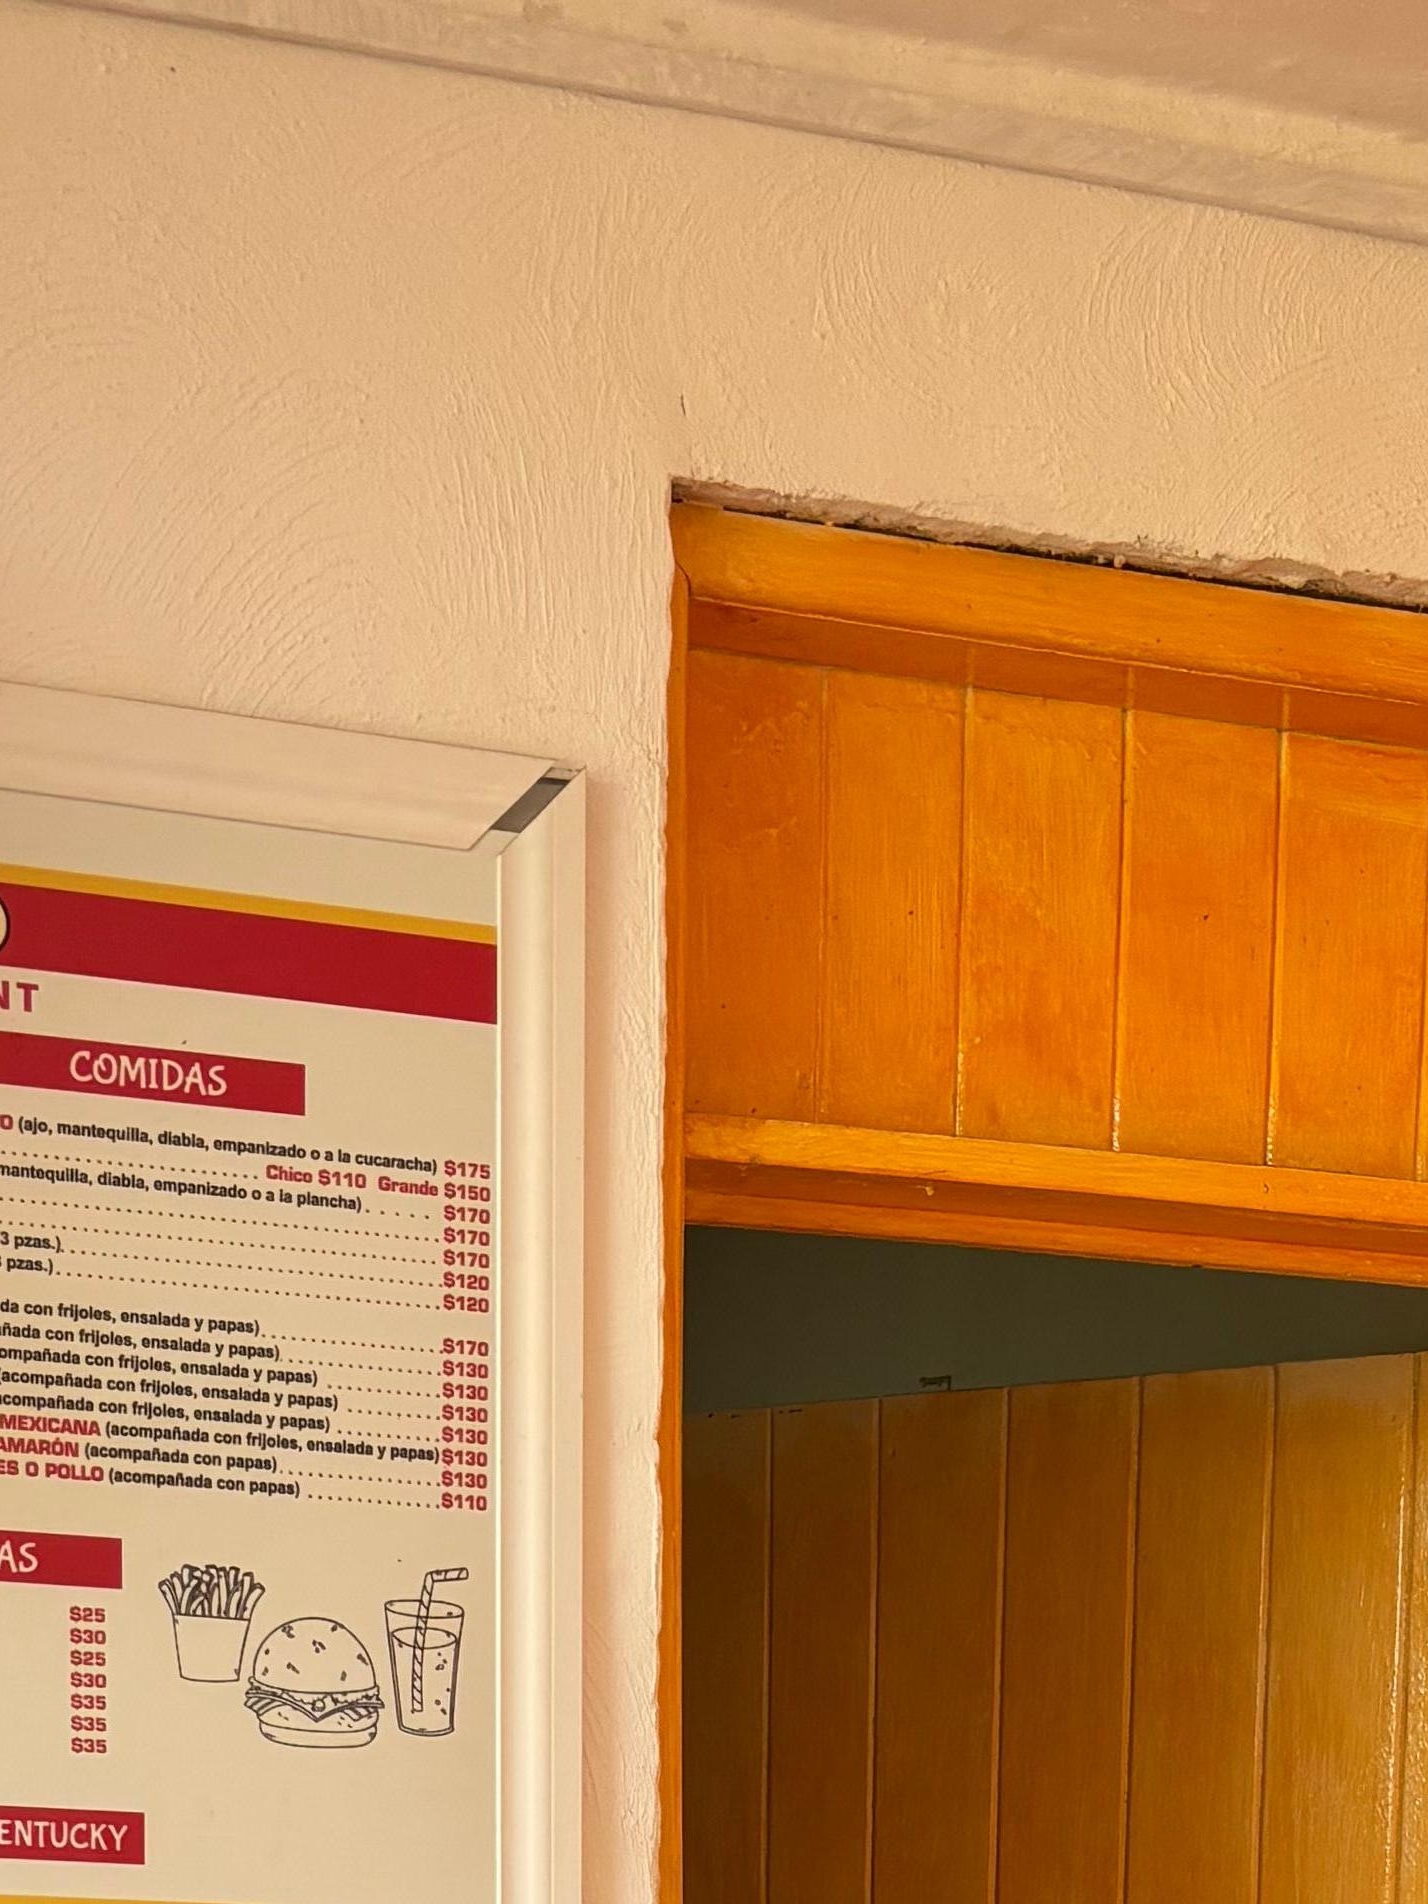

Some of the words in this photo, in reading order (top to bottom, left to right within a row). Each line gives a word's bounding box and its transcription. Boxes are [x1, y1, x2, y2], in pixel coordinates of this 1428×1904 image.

[69, 1050, 227, 1096] COMIDAS
[265, 1164, 312, 1183] Chico
[317, 1168, 366, 1189] $110
[378, 1175, 438, 1196] Grande
[444, 1181, 491, 1202] $150
[443, 1226, 490, 1246] $170
[443, 1248, 490, 1269] $170
[443, 1270, 489, 1291] $120
[45, 1328, 74, 1342] con
[141, 1336, 210, 1353] ensalada
[215, 1343, 224, 1357] y
[442, 1359, 488, 1379] $130
[69, 1605, 105, 1623] $25
[69, 1627, 106, 1645] $30
[70, 1649, 106, 1667] $25
[70, 1671, 106, 1688] $30
[70, 1693, 106, 1710] $35
[70, 1714, 107, 1732] $35
[71, 1736, 107, 1754] $35
